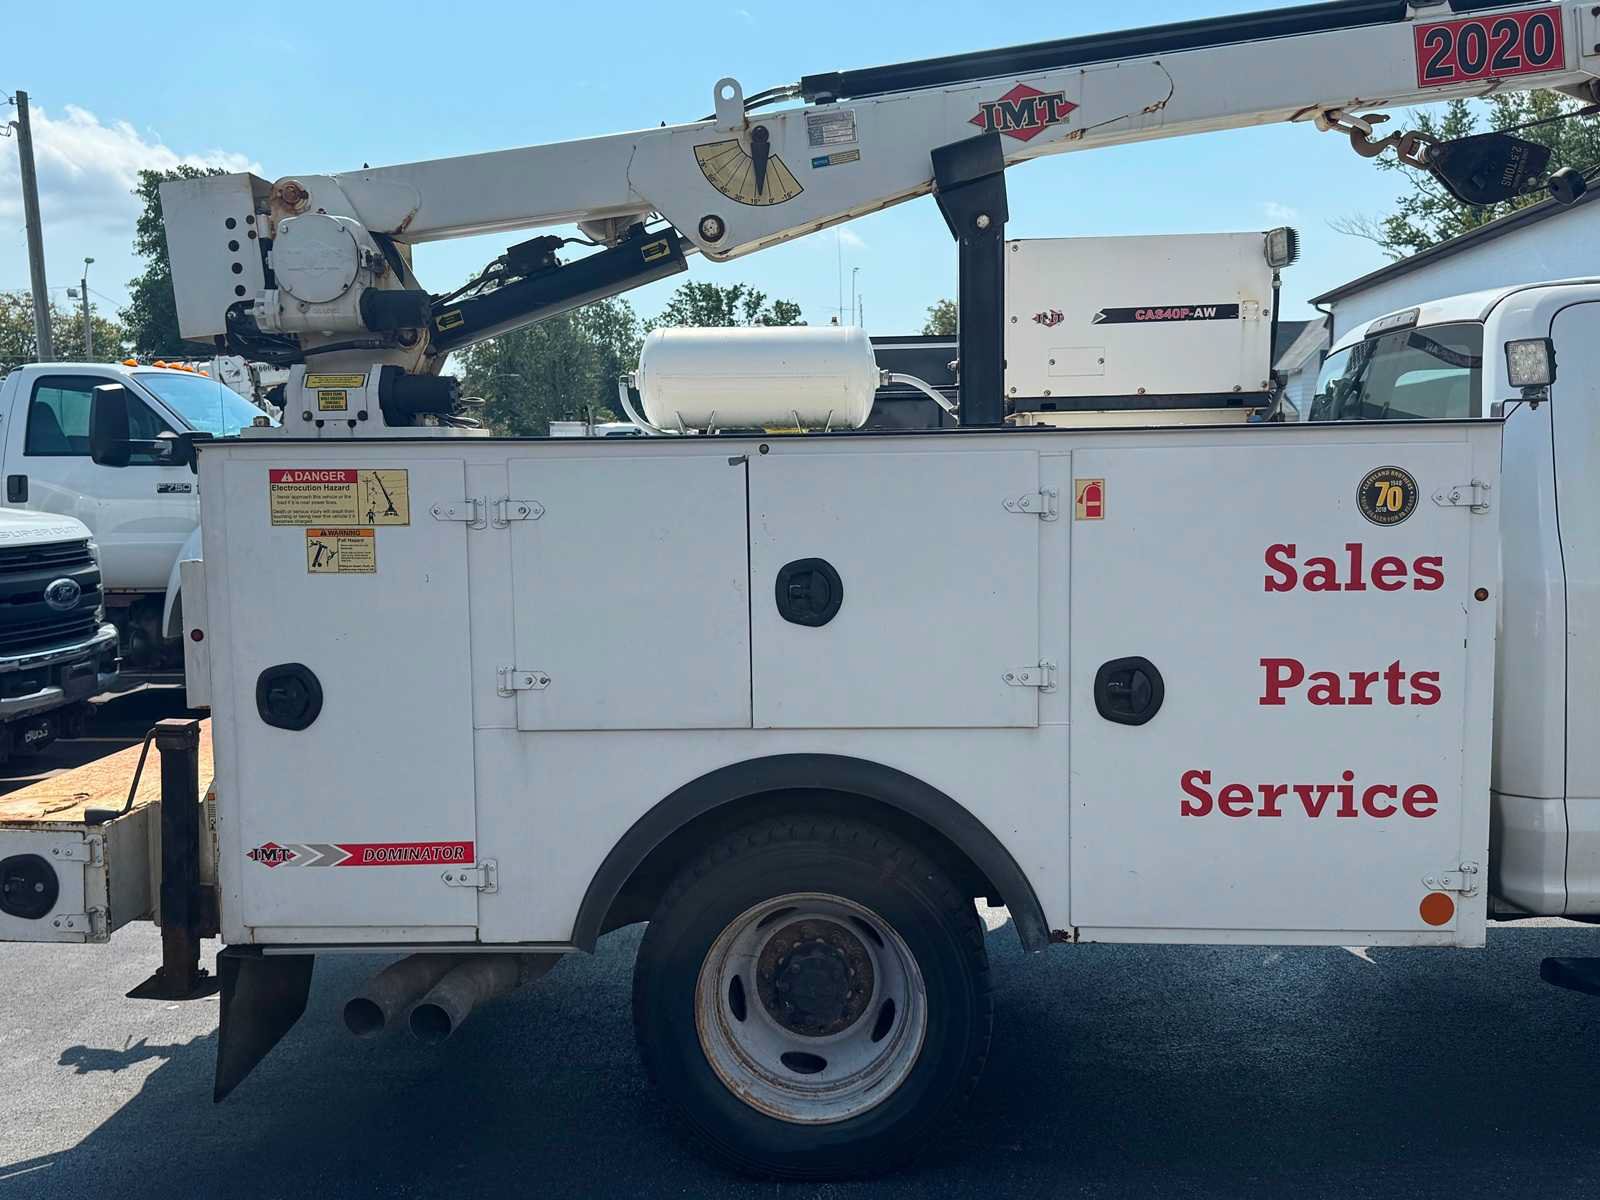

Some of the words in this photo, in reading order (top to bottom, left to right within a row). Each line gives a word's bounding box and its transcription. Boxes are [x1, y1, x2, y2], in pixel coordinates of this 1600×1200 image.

[1424, 13, 1556, 80] 2020
[979, 91, 1065, 134] IMT
[1135, 307, 1217, 321] CAS40P-AW
[271, 484, 322, 492] Electrocution
[294, 471, 346, 481] DANGER
[1375, 481, 1403, 511] 70
[1264, 543, 1445, 592] Sales
[1259, 658, 1442, 706] Parts
[1180, 770, 1439, 818] Service
[251, 848, 291, 861] IMT
[362, 847, 465, 862] DOMINATOR
